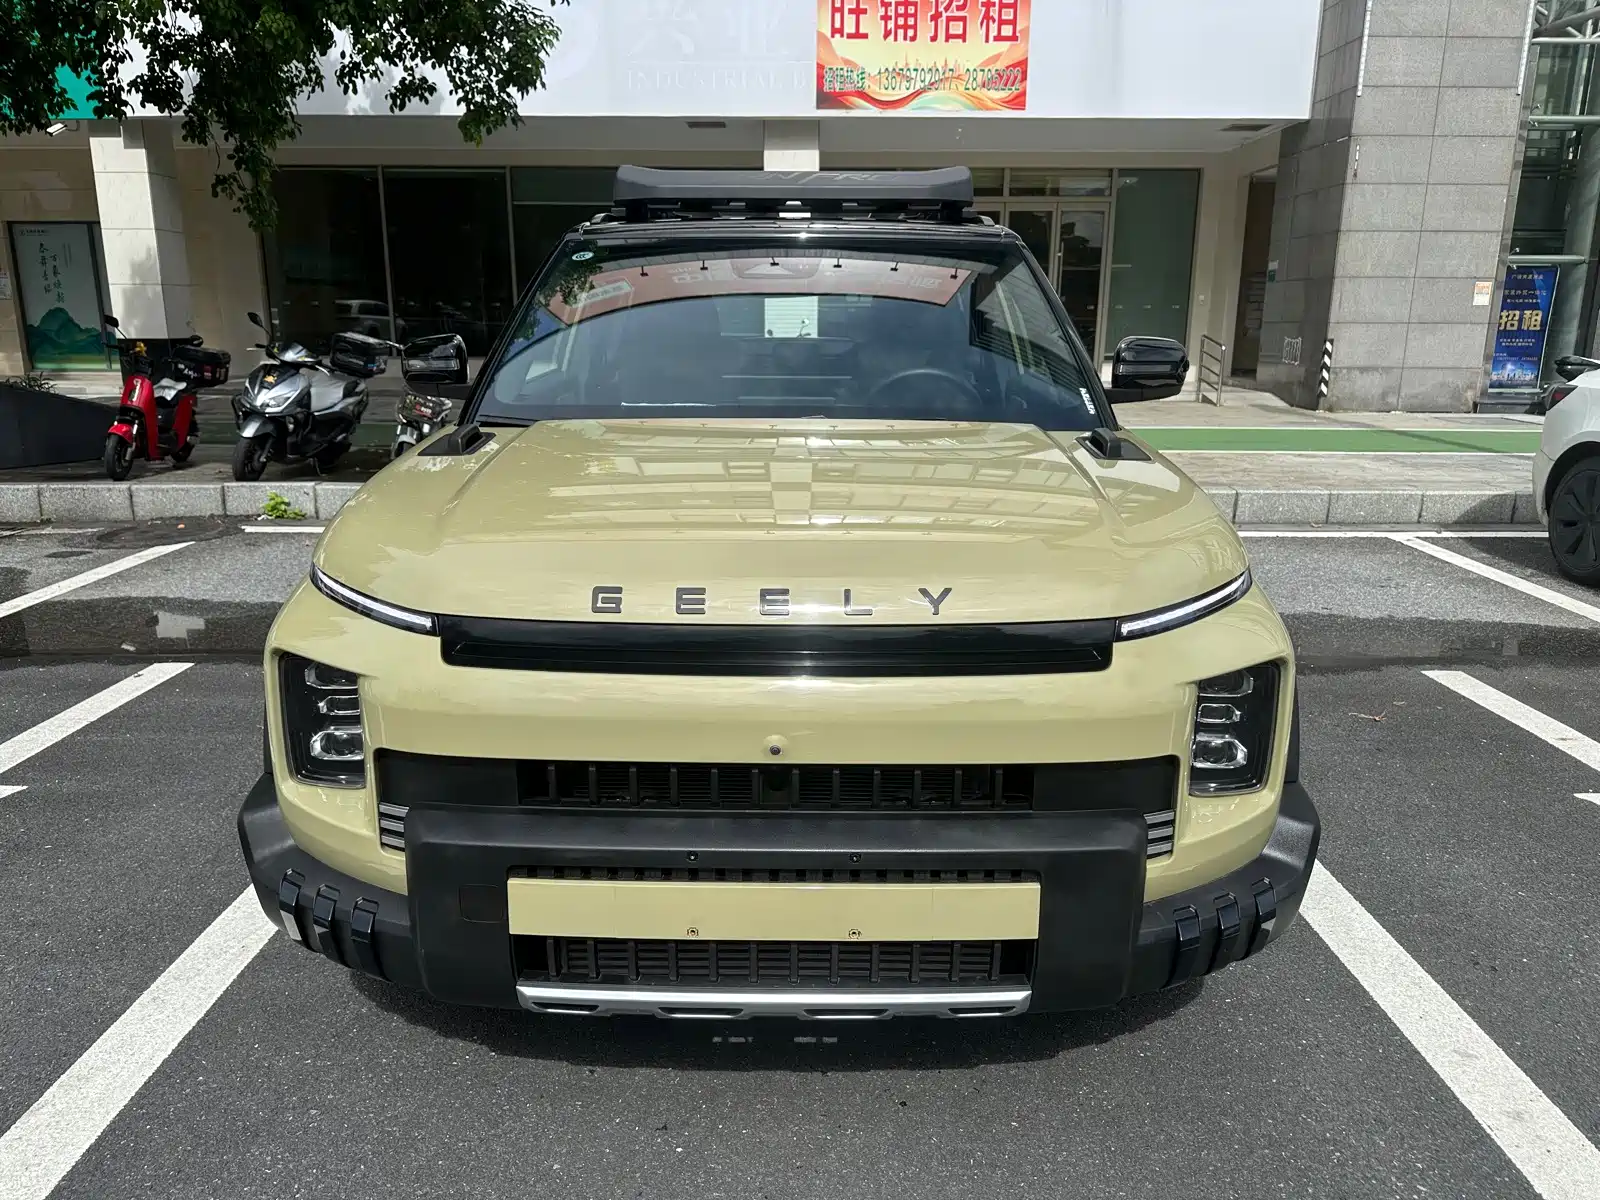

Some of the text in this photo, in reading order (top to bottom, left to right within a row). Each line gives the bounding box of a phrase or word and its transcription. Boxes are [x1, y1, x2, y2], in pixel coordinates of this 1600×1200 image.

[830, 0, 1019, 43] 旺铺招租
[1498, 309, 1543, 331] 招租
[592, 586, 952, 616] GEELY
